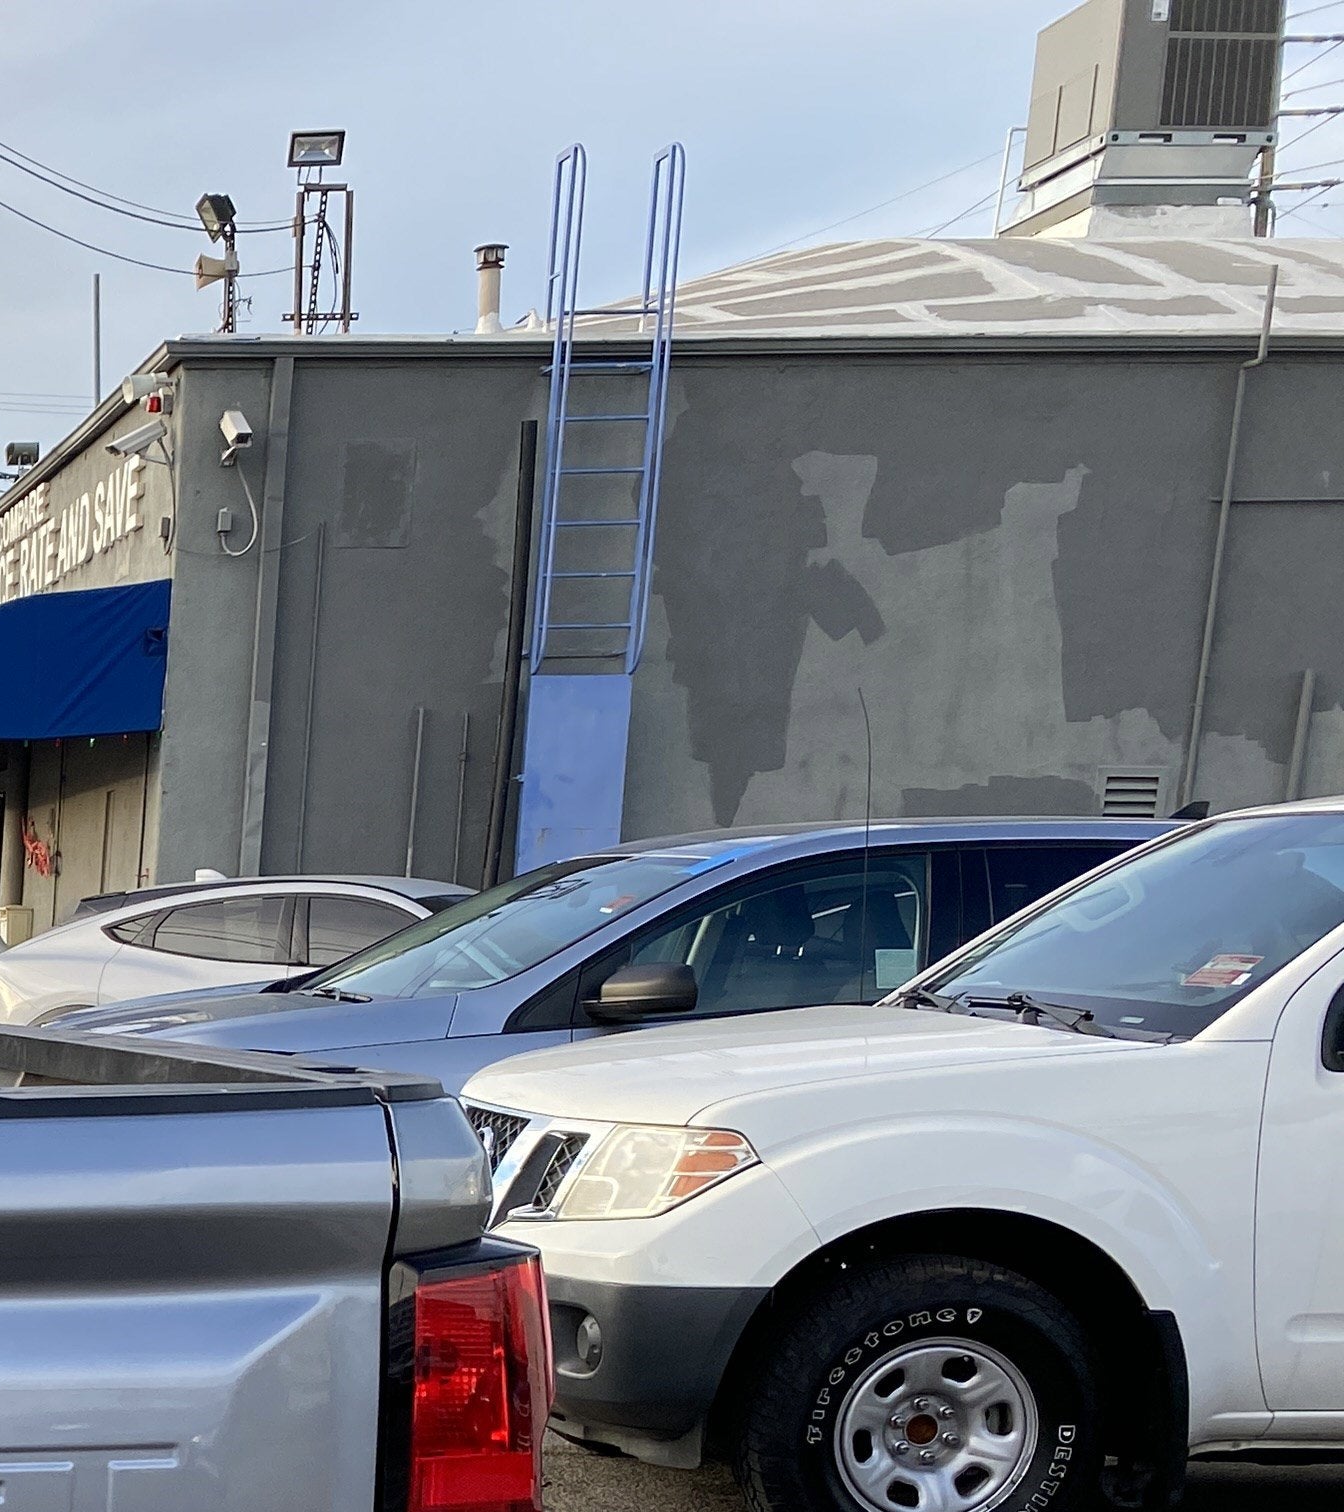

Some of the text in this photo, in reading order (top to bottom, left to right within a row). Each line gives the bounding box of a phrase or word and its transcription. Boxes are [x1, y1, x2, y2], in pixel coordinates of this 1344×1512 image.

[20, 517, 57, 600] RATE
[56, 492, 91, 579] AND
[93, 453, 142, 554] SAVE
